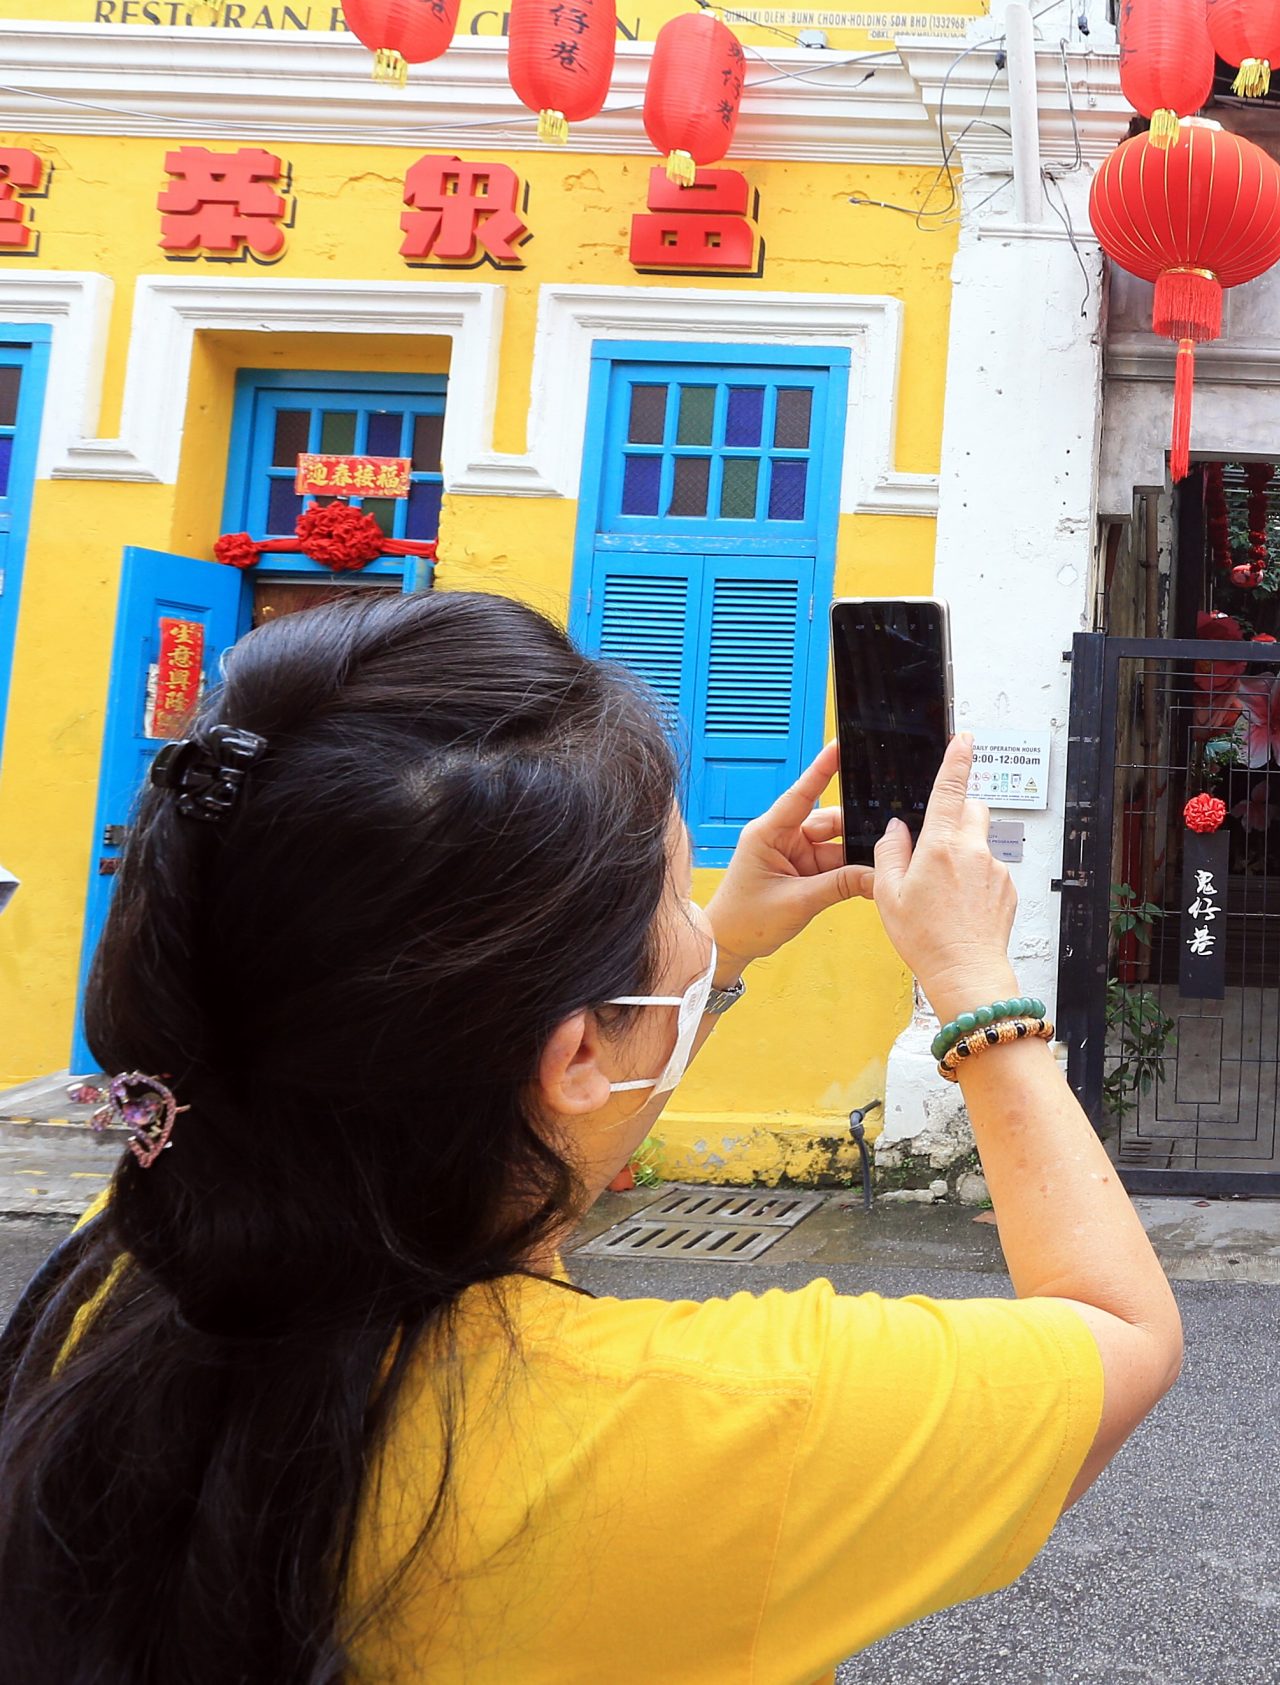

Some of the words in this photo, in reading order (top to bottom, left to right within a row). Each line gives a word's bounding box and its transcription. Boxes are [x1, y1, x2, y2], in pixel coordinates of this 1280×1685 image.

[890, 15, 907, 27] SDN
[910, 15, 927, 28] BHD
[307, 462, 401, 488] 迎春接福
[1186, 869, 1221, 956] 鬼仔巷
